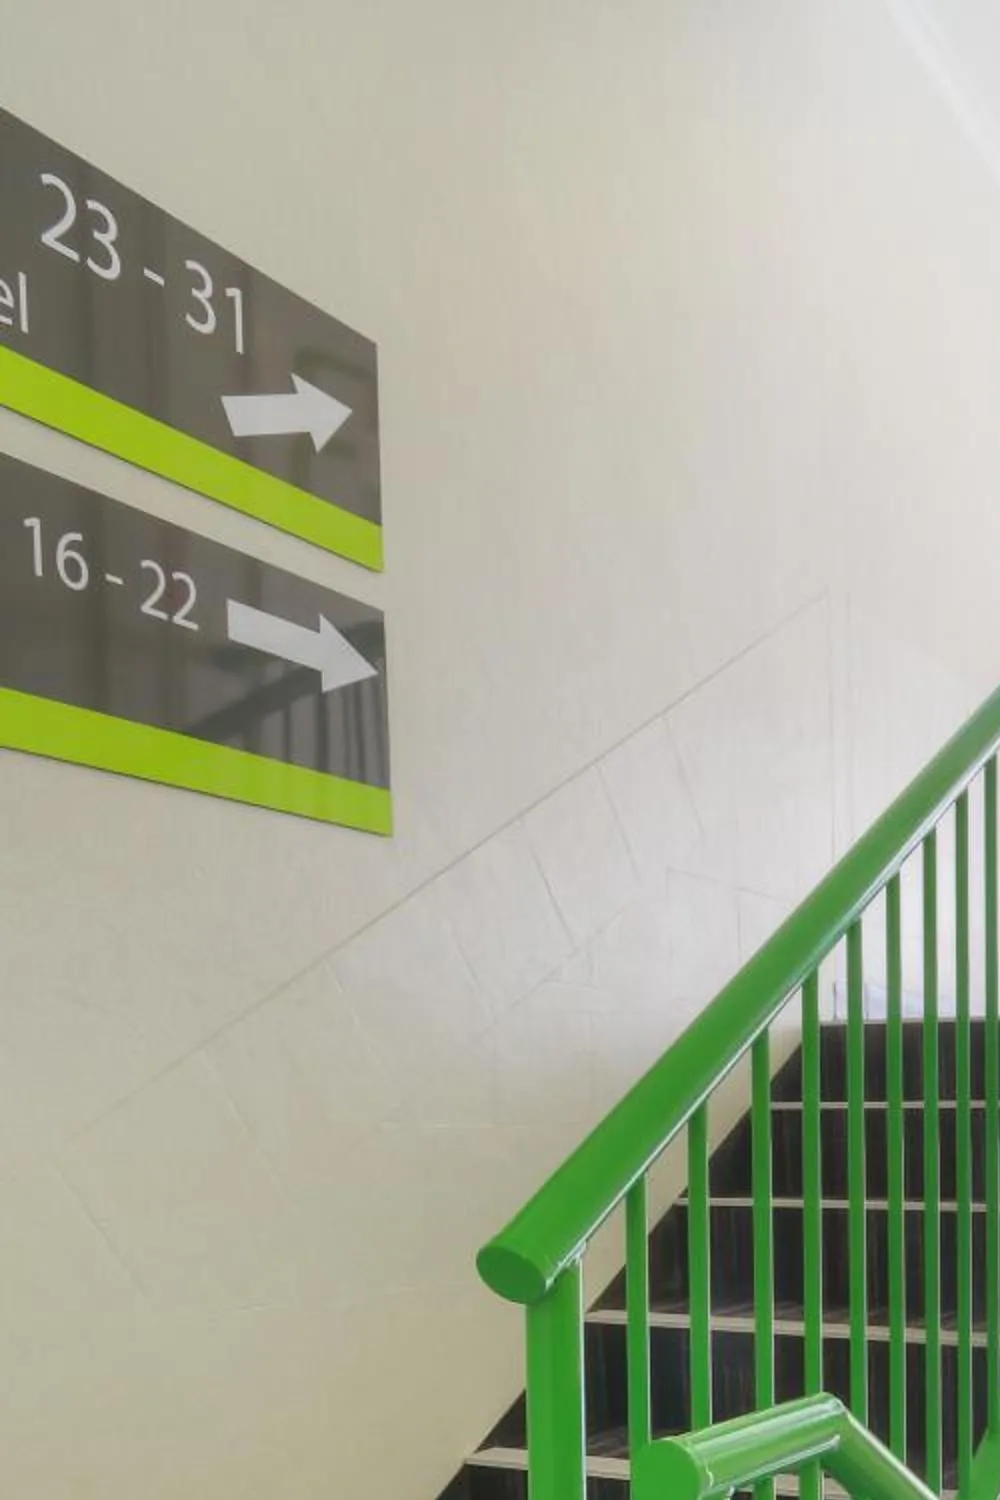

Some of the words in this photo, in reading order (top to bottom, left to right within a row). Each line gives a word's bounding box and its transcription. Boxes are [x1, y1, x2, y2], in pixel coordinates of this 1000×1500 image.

[40, 173, 121, 280] 23
[185, 259, 244, 355] 31
[23, 517, 89, 591] 16
[140, 559, 199, 631] 22
